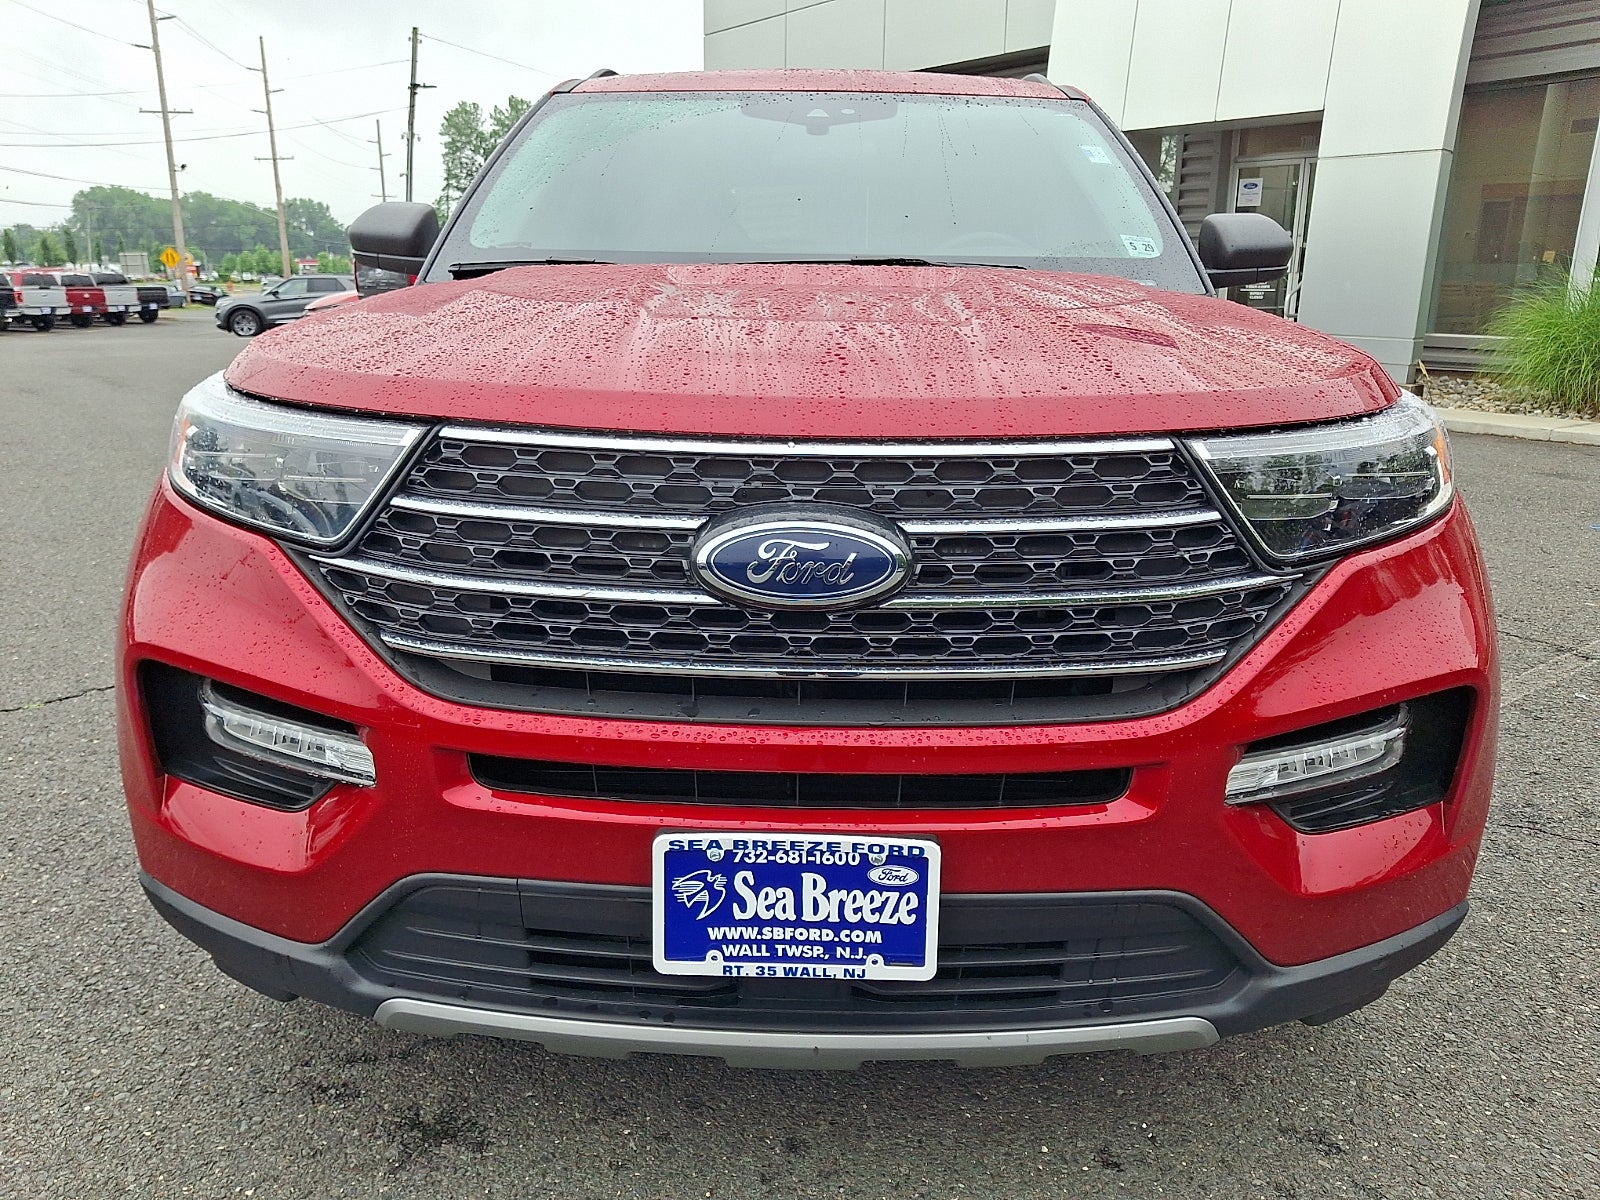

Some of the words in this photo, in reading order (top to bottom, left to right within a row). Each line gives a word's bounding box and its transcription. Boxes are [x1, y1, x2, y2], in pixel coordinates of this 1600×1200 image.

[1129, 242, 1137, 250] 5
[1142, 243, 1155, 252] 29
[747, 539, 859, 585] Ford
[668, 839, 724, 851] SEA
[732, 839, 842, 854] BREEZE
[851, 842, 926, 858] FORD
[732, 849, 860, 866] 732-681-1600
[877, 868, 909, 882] Ford
[732, 870, 797, 920] Sea
[800, 872, 919, 925] Breeze
[707, 926, 882, 944] WWW.SBFORD.COM
[721, 944, 771, 957] WALL
[835, 946, 868, 960] N.J.
[722, 965, 749, 977] RT.
[755, 966, 777, 977] 35
[783, 966, 837, 979] WALL,
[843, 968, 866, 979] NJ
